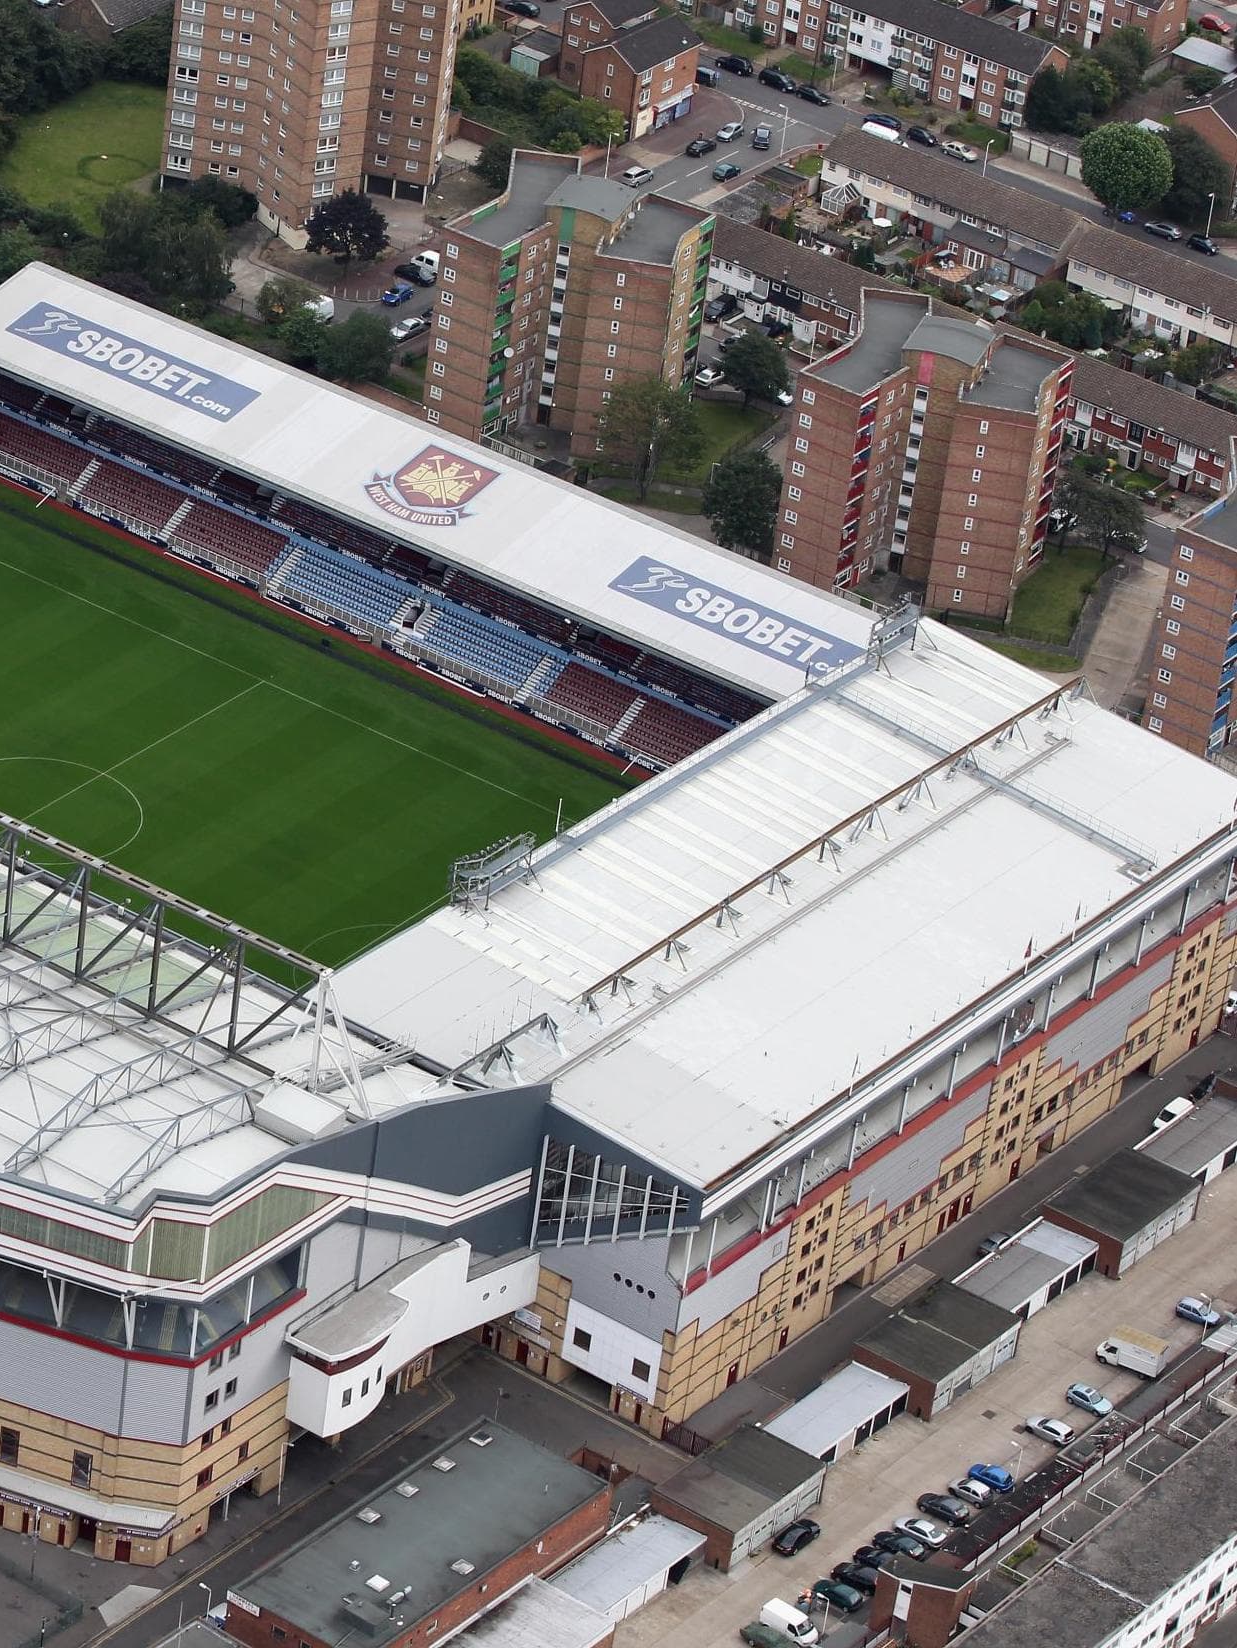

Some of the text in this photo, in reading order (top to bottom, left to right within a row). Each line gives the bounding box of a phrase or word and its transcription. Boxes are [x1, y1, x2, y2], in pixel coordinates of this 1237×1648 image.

[67, 329, 232, 417] SBOBET.com
[369, 484, 453, 525] WEST HAM UNITED
[675, 588, 837, 673] SBOBET.c
